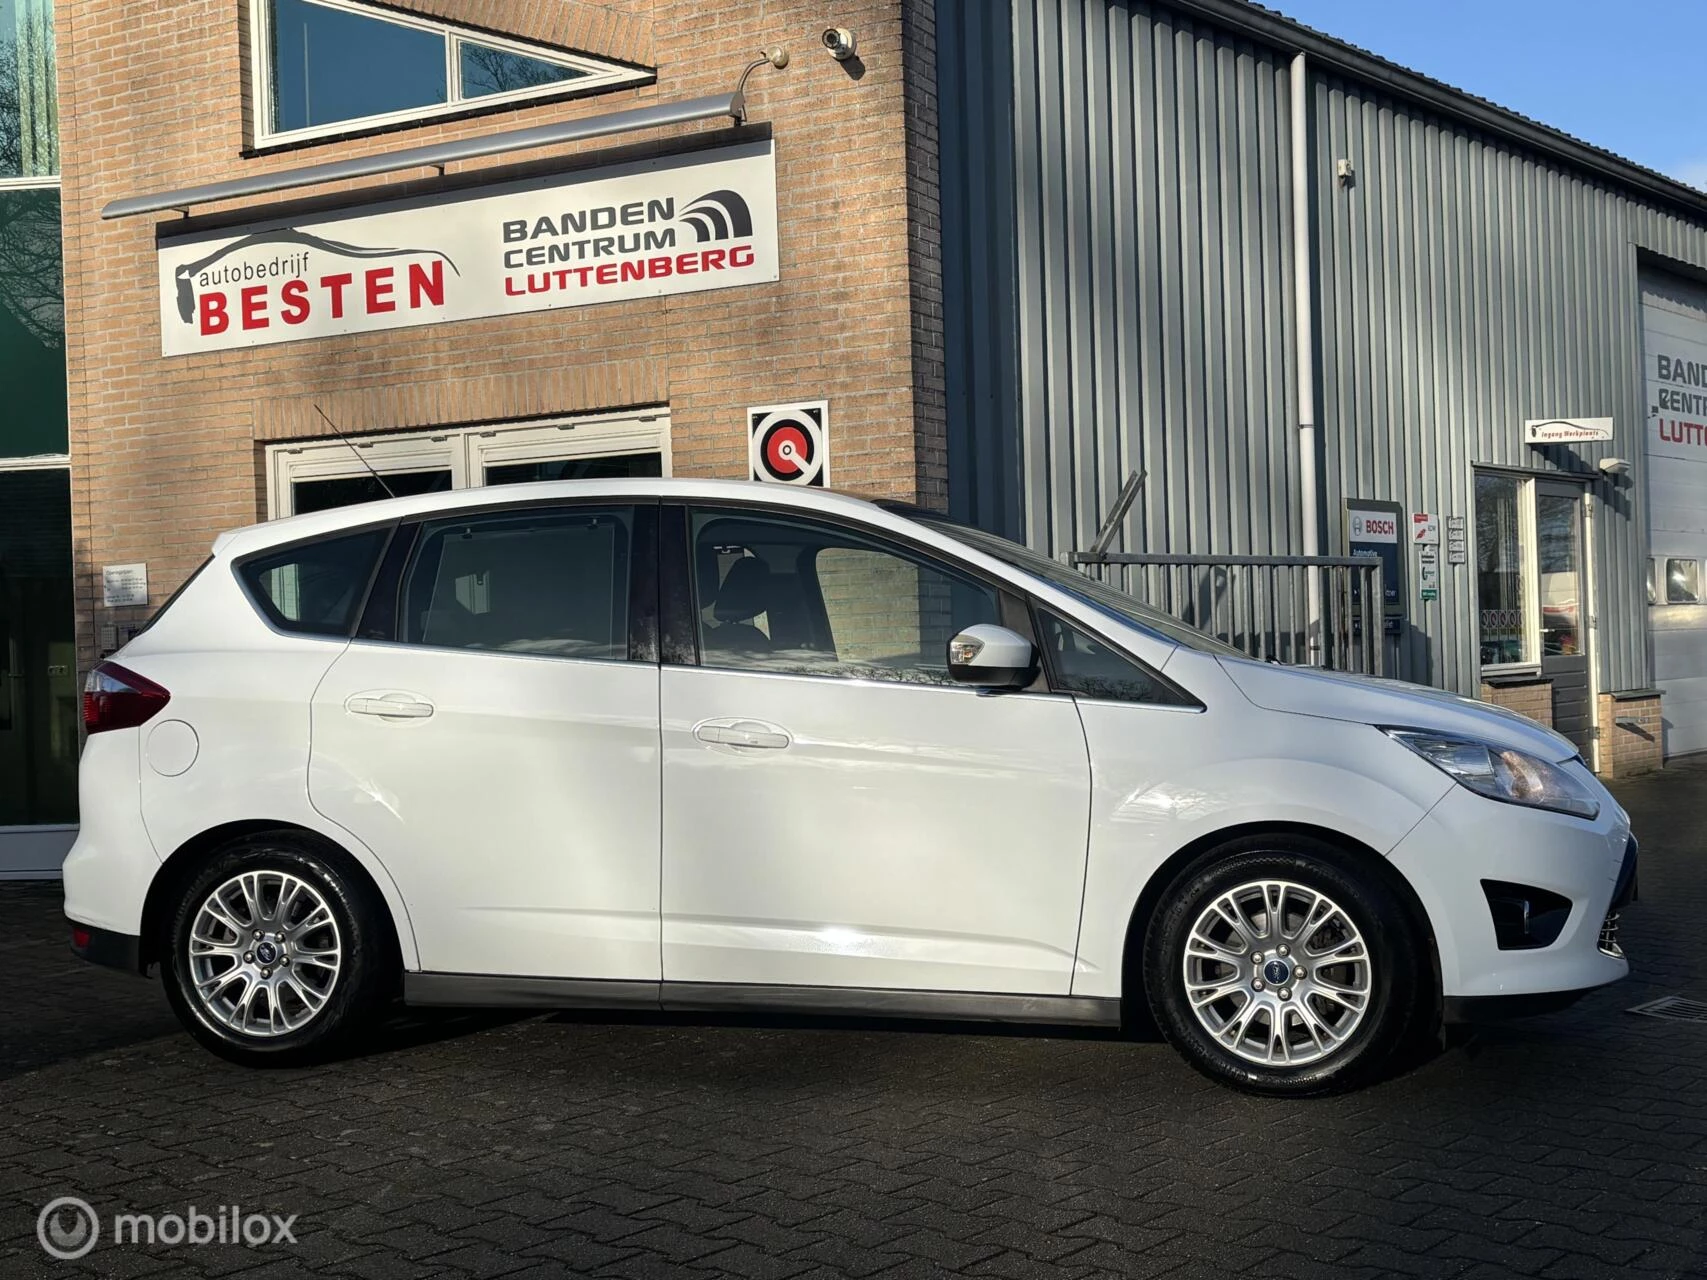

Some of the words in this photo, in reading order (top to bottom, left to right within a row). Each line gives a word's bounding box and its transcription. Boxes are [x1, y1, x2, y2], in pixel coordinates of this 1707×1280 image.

[502, 197, 675, 243] BANDEN
[503, 227, 677, 269] CENTRUM
[199, 252, 310, 287] autobedrijf
[504, 245, 755, 297] LUTTENBERG
[200, 260, 446, 336] BESTEN
[1659, 418, 1707, 447] LUTT
[1365, 519, 1395, 535] BOSCH
